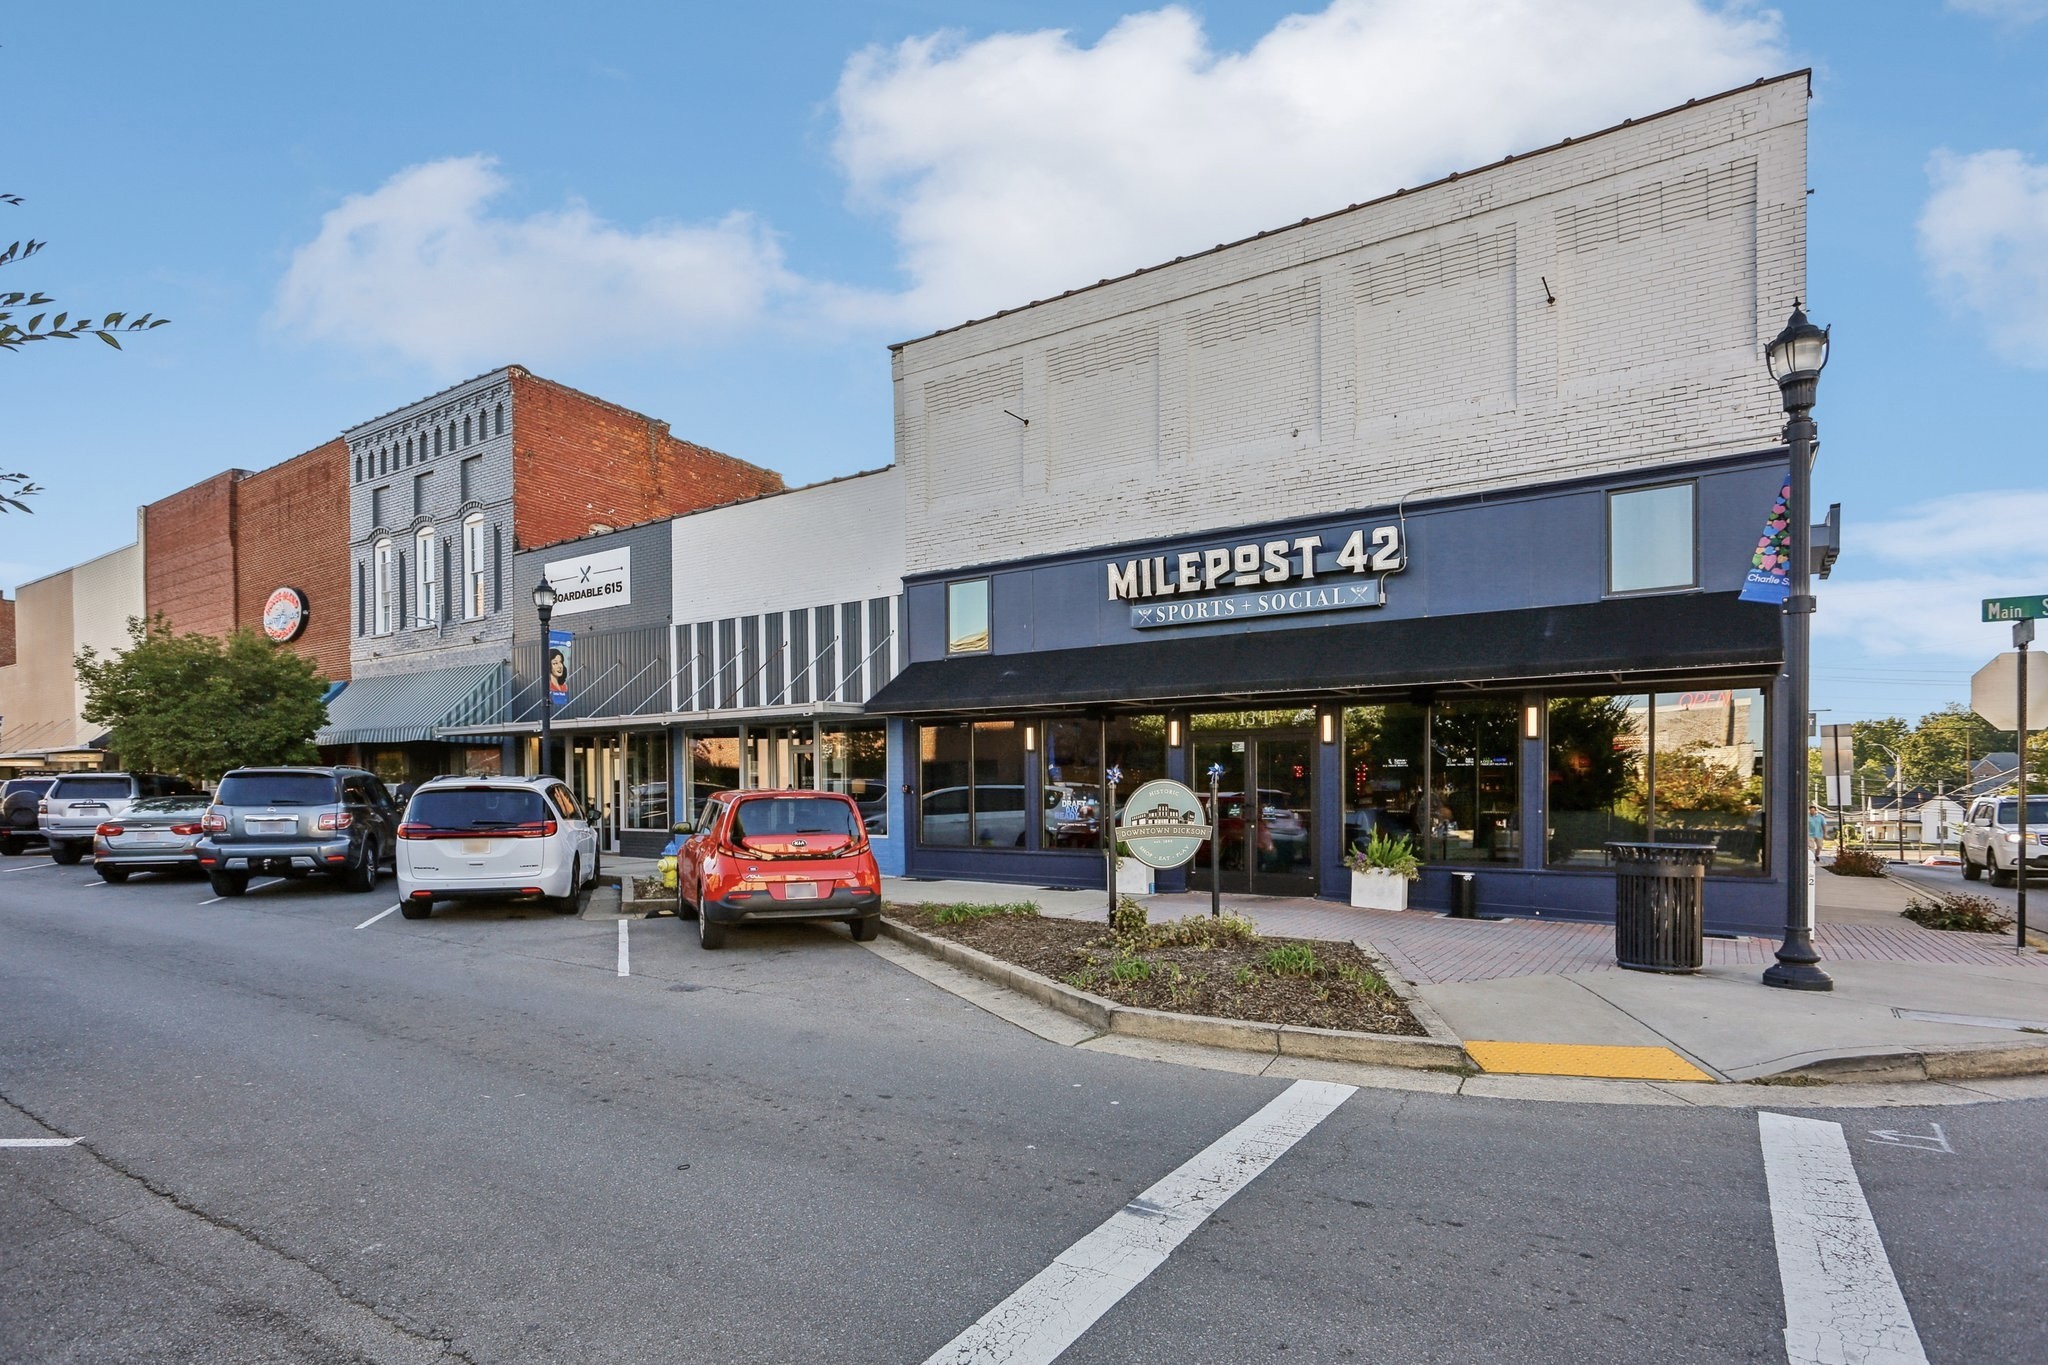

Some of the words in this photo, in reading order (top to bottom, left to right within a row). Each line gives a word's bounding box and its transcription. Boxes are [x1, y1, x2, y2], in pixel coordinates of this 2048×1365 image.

[1107, 535, 1323, 601] MILEPOST
[1336, 525, 1402, 573] 42
[1748, 573, 1780, 584] Charlie
[604, 581, 623, 595] 615
[1155, 600, 1235, 623] SPORTS
[1258, 587, 1346, 613] SOCIAL
[1988, 602, 2022, 620] Main
[1679, 690, 1732, 708] OPEN
[1148, 788, 1180, 797] HISTORIC
[1062, 800, 1086, 808] DRAFT
[1121, 827, 1170, 837] DOWNTOWN
[1173, 827, 1206, 836] DICKSON
